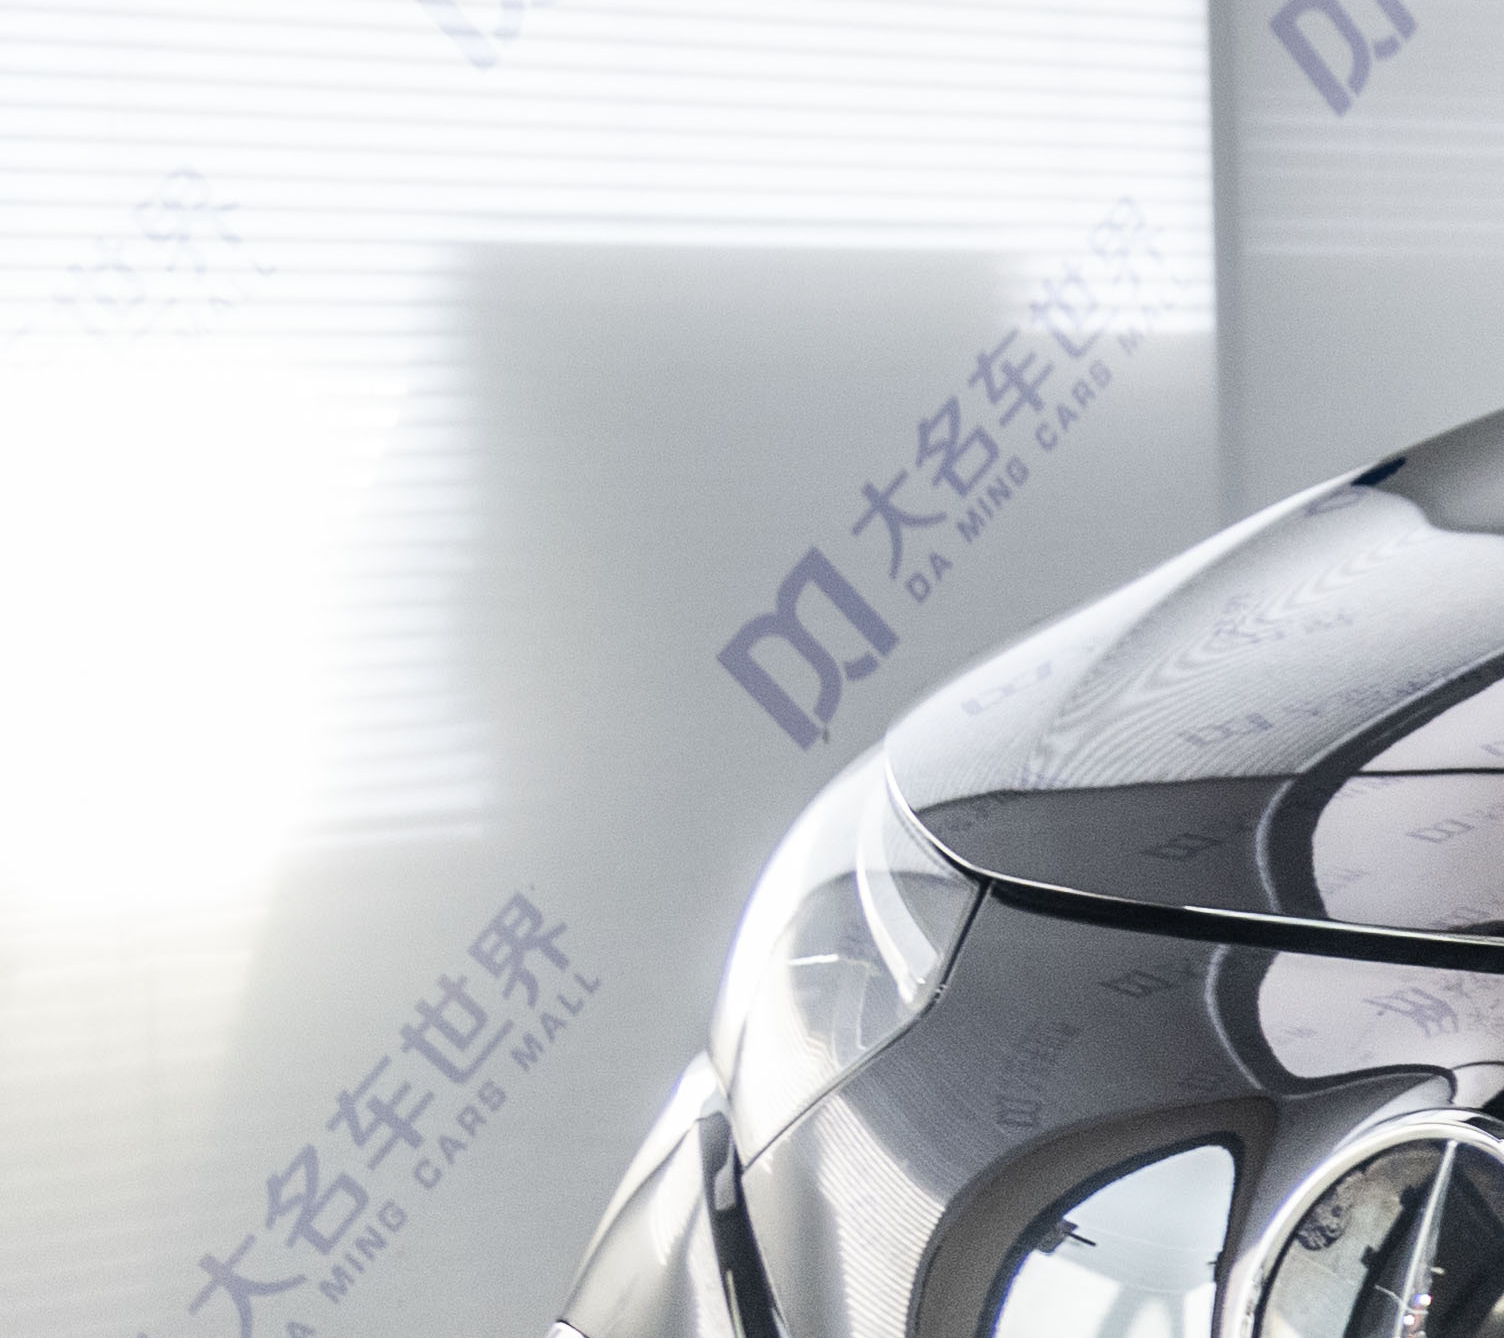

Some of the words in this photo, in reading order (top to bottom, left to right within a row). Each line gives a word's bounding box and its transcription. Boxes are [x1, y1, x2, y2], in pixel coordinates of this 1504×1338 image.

[851, 195, 1167, 581] 大名车世界
[904, 549, 954, 605] DA
[955, 460, 1031, 545] MING
[1033, 359, 1115, 452] CARS
[318, 1197, 410, 1305] MING
[411, 1078, 509, 1191] CARS
[508, 970, 604, 1072] MALL
